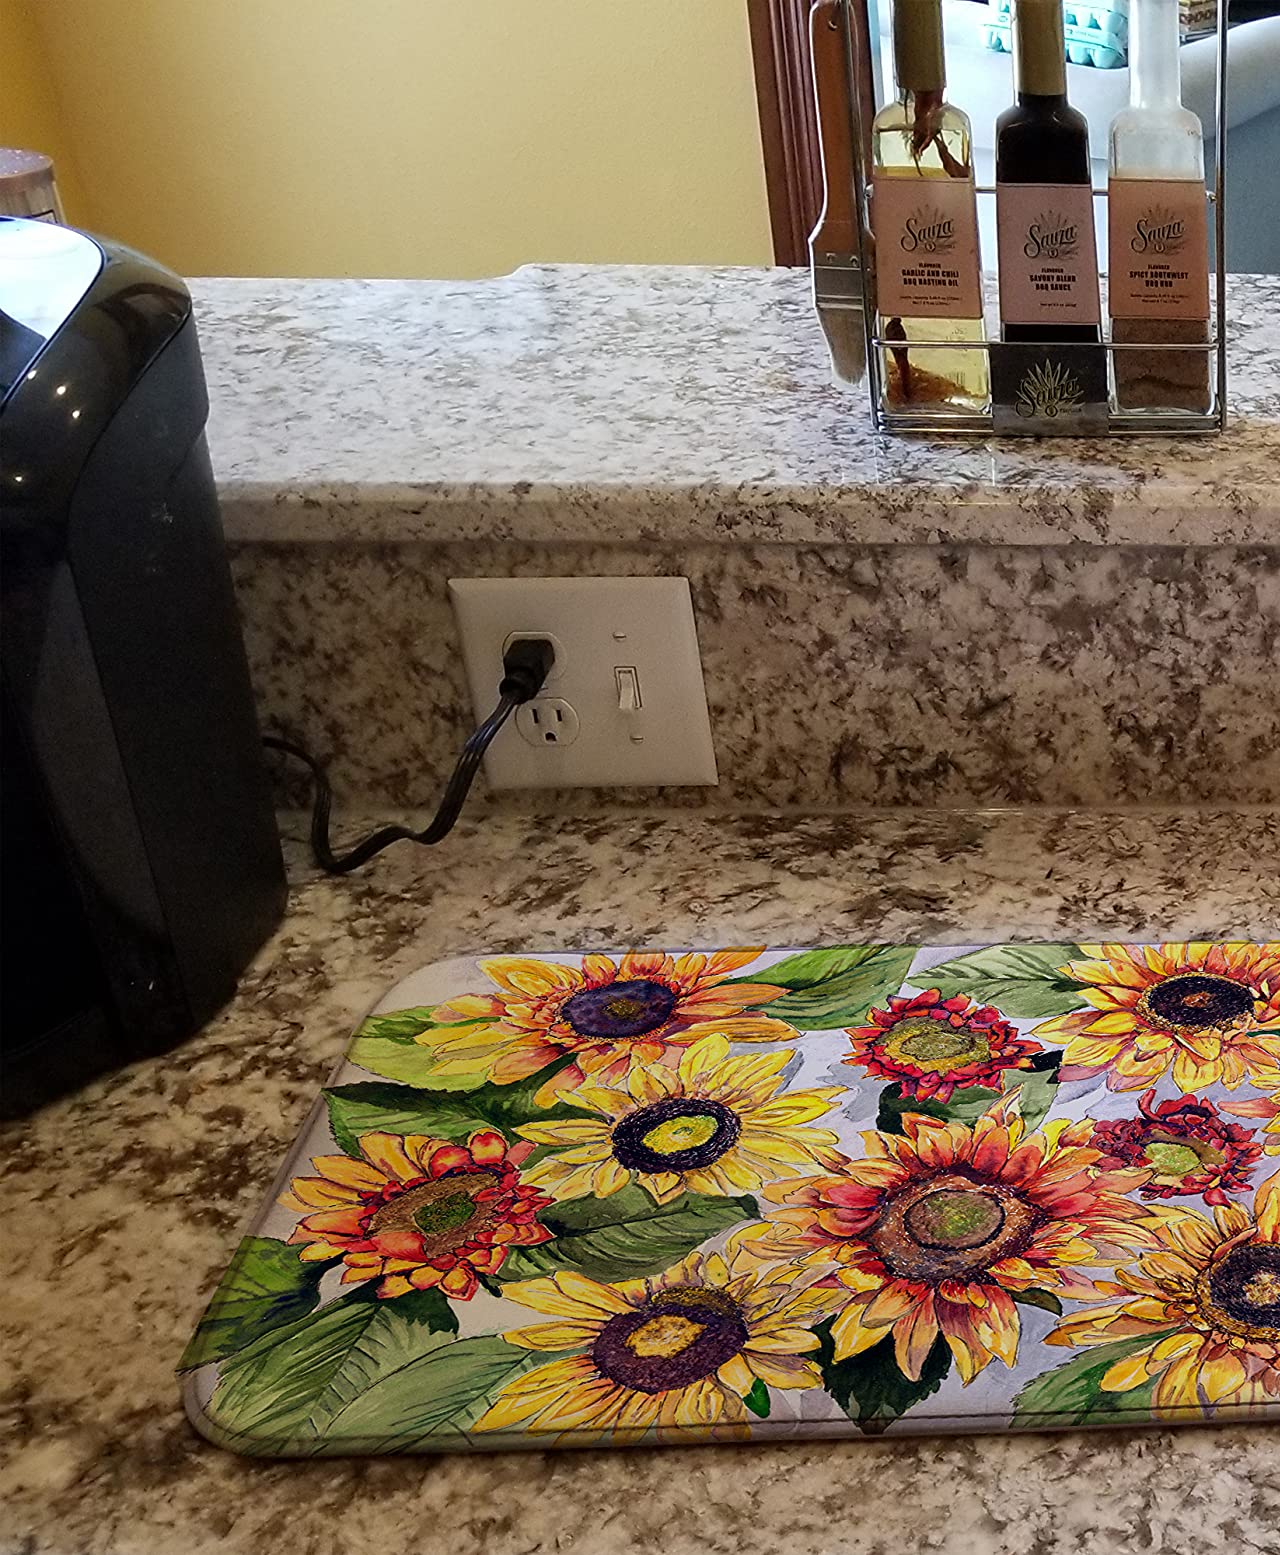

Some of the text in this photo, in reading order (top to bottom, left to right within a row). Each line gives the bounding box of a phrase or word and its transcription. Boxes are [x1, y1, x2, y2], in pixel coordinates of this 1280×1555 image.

[901, 217, 954, 252] Sauza
[1130, 218, 1185, 253] Sauza
[1023, 224, 1078, 259] Sauza
[901, 269, 960, 278] GARLIC AND CHILI
[1029, 274, 1076, 283] SAVORY BLEND
[1129, 270, 1189, 280] SPICY SOUTHWEST
[903, 278, 959, 287] BBQ BASTING OIL
[1035, 283, 1072, 291] BBQ SAUCE
[1015, 378, 1079, 418] Sauza
